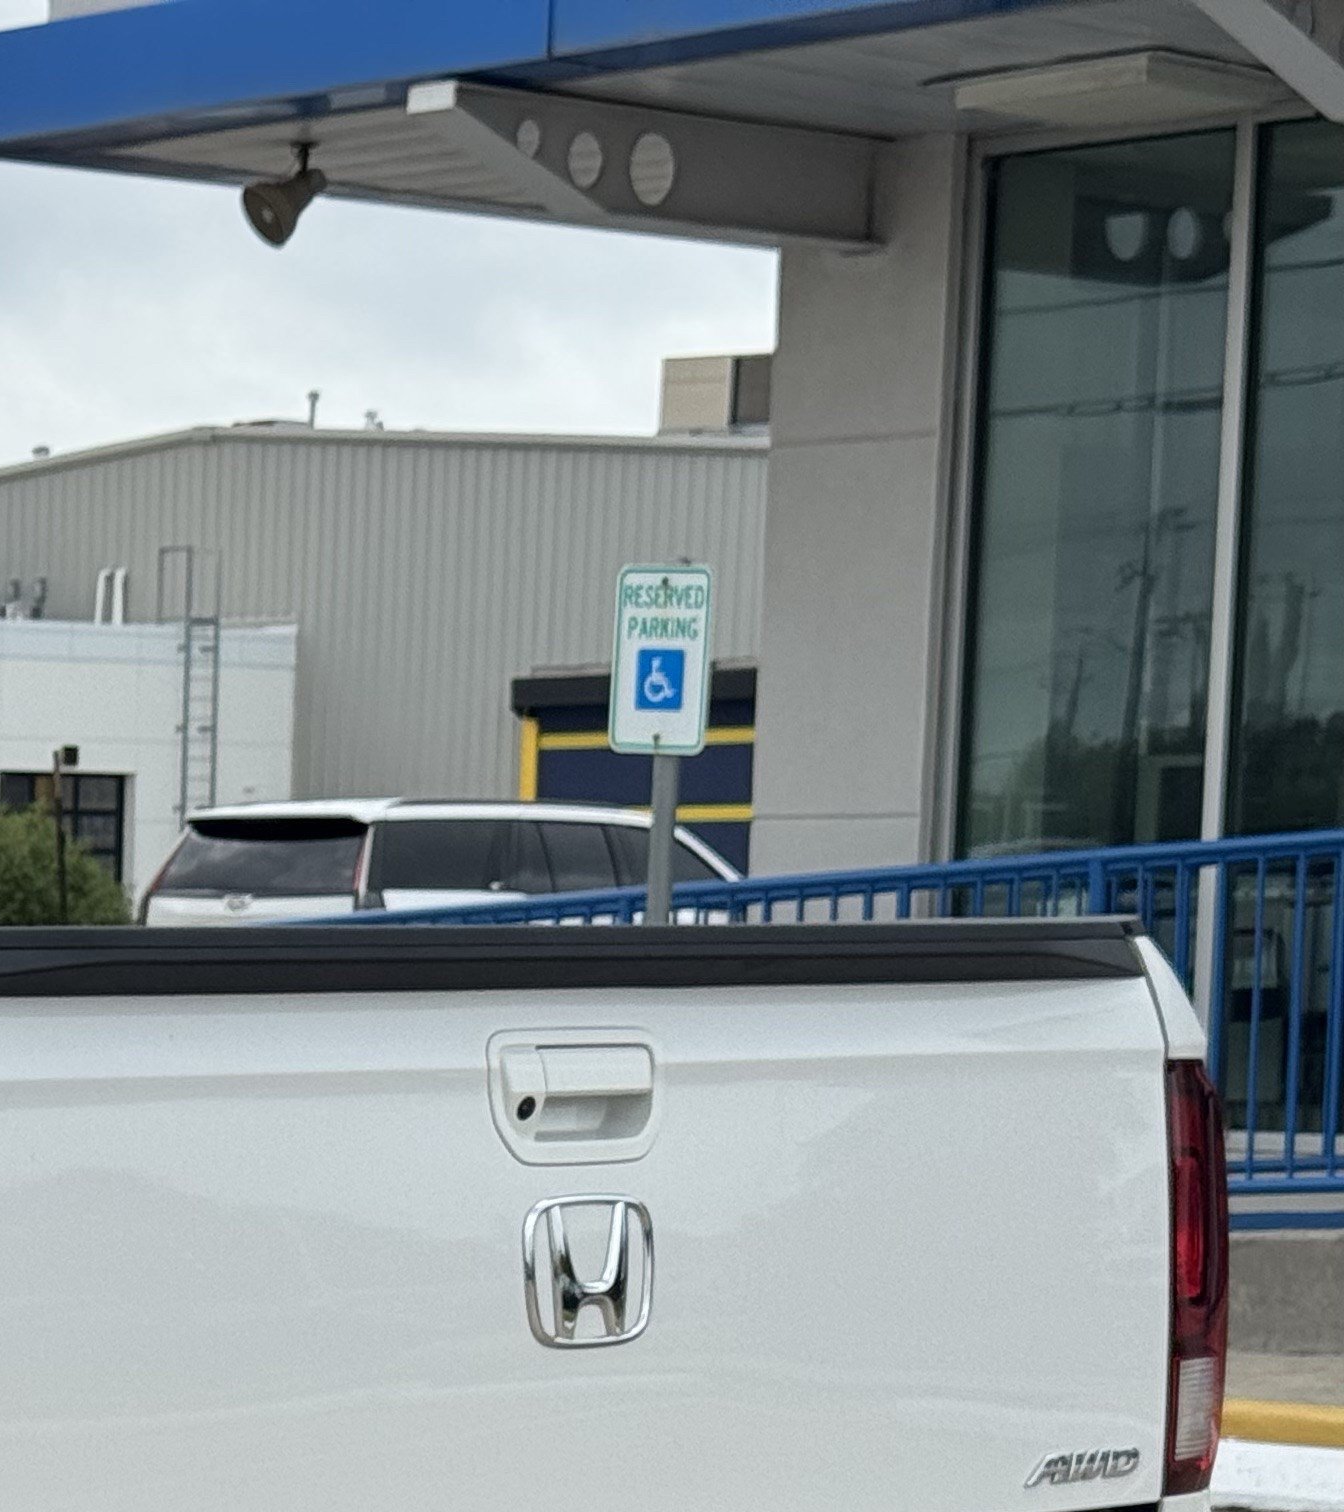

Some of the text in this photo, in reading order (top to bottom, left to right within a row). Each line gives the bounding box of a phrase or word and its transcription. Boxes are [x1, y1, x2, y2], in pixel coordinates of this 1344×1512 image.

[622, 584, 704, 609] RESERVED
[627, 616, 698, 640] PARKING
[1024, 1446, 1140, 1489] AWD
